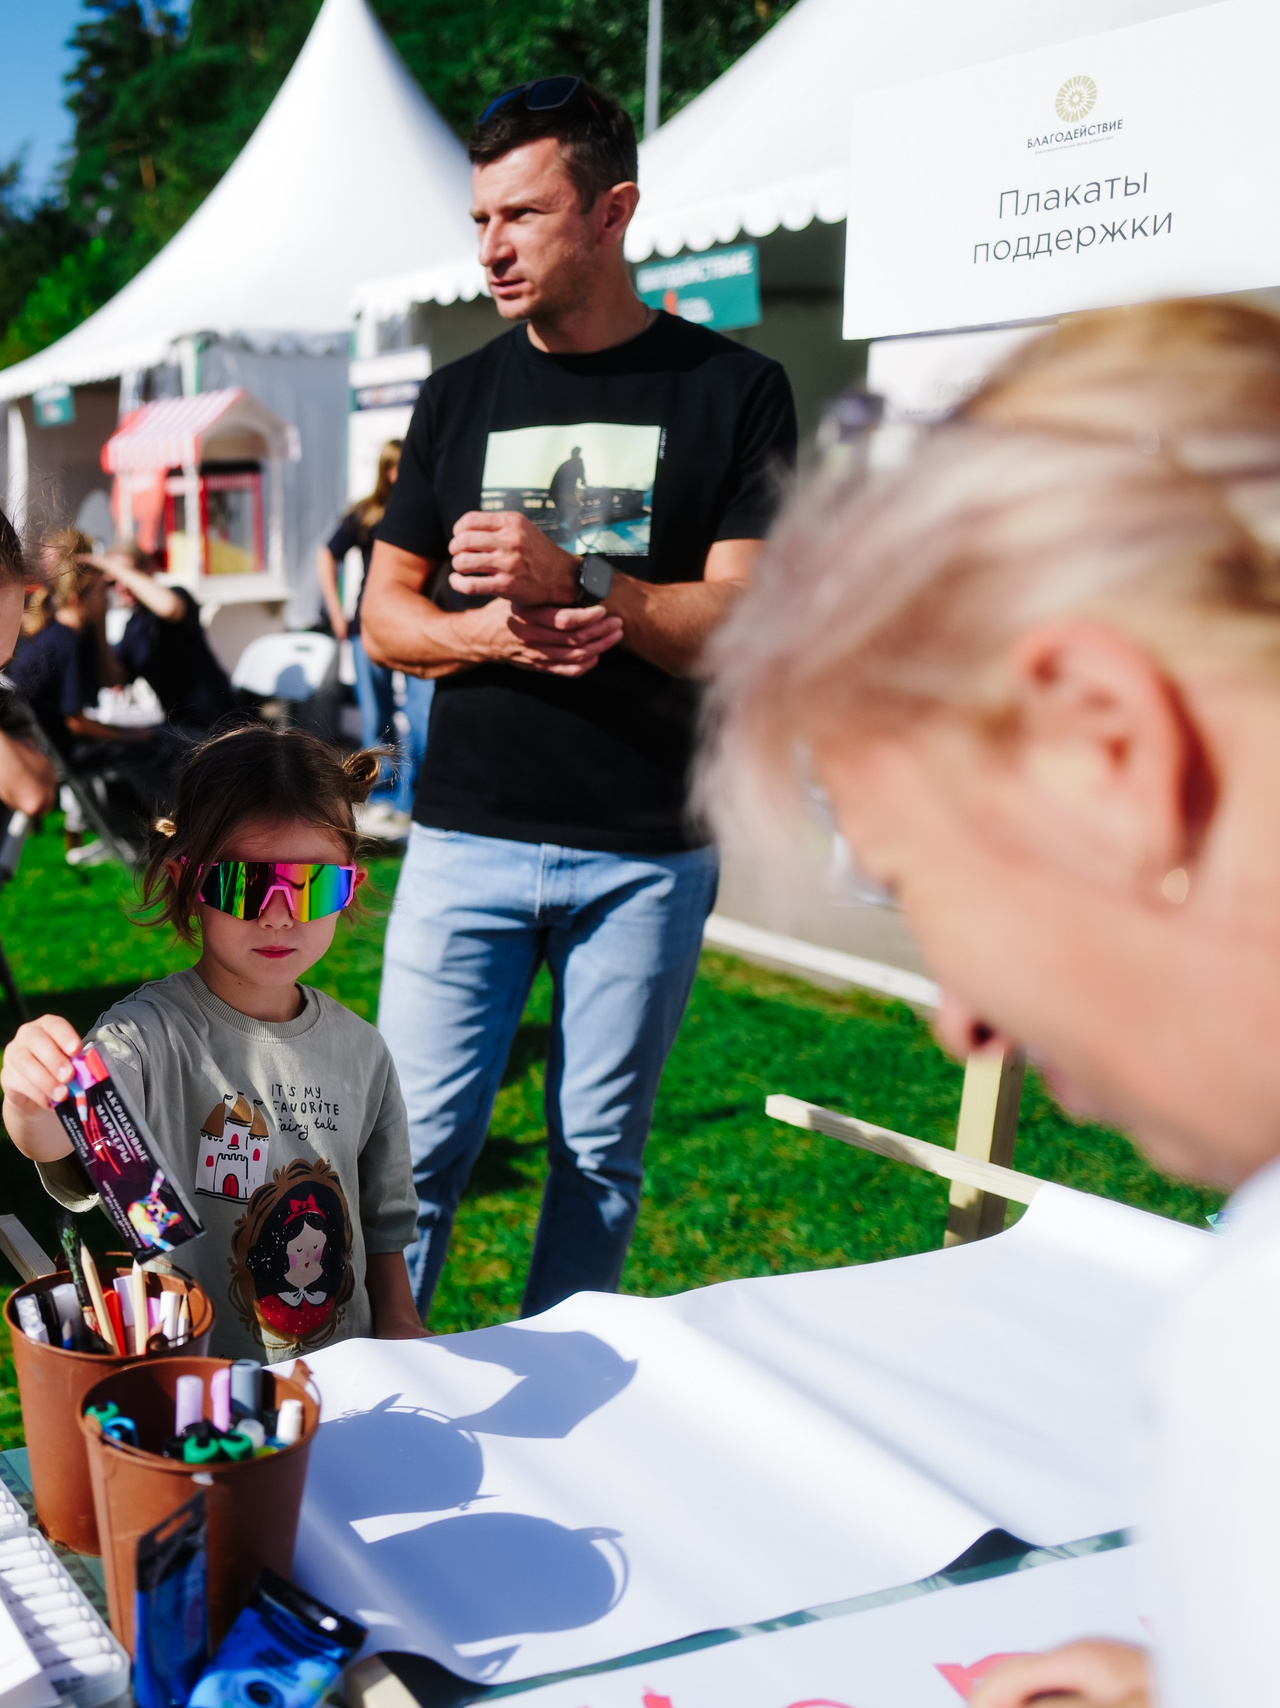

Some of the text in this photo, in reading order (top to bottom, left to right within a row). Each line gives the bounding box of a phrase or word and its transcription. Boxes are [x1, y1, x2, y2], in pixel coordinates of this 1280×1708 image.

[1027, 119, 1123, 148] БЛАГОДЕЙСТВИЕ
[998, 172, 1148, 219] Плакаты
[973, 212, 1173, 264] поддержки
[272, 1084, 321, 1099] IT'S MY
[94, 1103, 132, 1164] МАРКЕРЫ
[314, 1117, 338, 1131] tale
